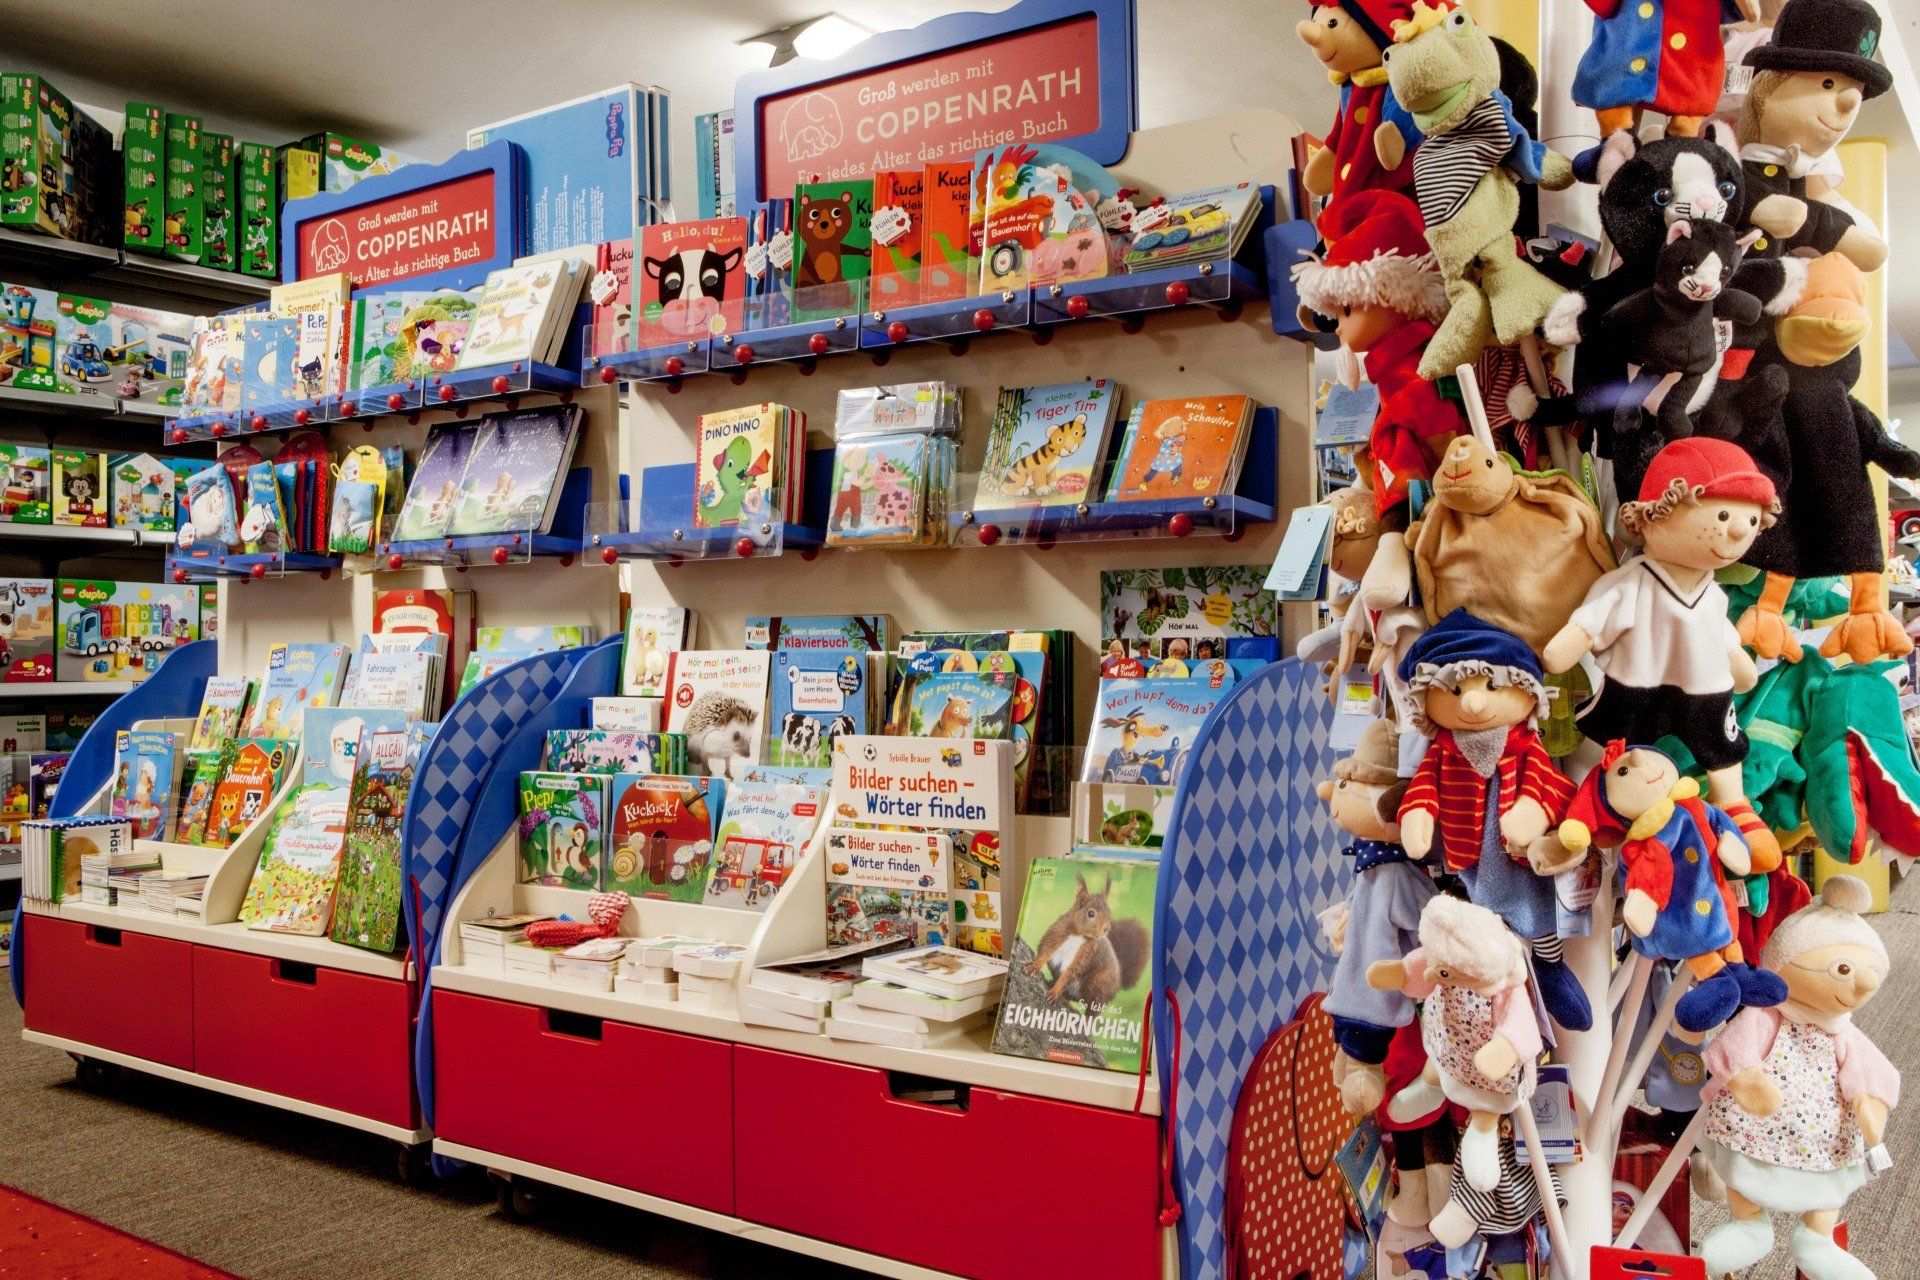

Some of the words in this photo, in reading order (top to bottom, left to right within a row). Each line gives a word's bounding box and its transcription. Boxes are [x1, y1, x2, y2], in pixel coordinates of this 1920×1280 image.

[858, 81, 896, 107] Groß
[902, 66, 959, 95] werden
[966, 59, 994, 78] mit
[856, 67, 1082, 143] COPPENRATH
[608, 103, 623, 138] Peppa
[329, 142, 342, 153] LEGO
[345, 148, 373, 164] duplo
[609, 137, 624, 158] Pig
[826, 161, 866, 185] jedes
[871, 148, 911, 172] Alter
[918, 144, 944, 163] das
[949, 122, 1015, 153] richtige
[1021, 111, 1069, 138] Buch
[358, 215, 381, 232] Groß
[384, 206, 418, 225] werden
[422, 200, 438, 215] mit
[1100, 205, 1127, 218] FÜHLEN
[986, 220, 999, 229] Wer
[357, 209, 488, 261] COPPENRATH
[662, 227, 700, 243] Hallo,
[703, 225, 725, 236] du!
[365, 266, 391, 283] Alter
[394, 261, 409, 276] das
[412, 250, 450, 273] richtige
[453, 242, 480, 262] Buch
[76, 305, 104, 318] duplo
[287, 298, 326, 317] Sommer?
[1045, 392, 1077, 404] Kleiner
[1184, 402, 1206, 411] Mein
[1036, 404, 1070, 420] Tiger
[1074, 400, 1097, 412] Tim
[706, 426, 731, 441] DINO
[733, 418, 760, 433] NINO
[1187, 413, 1235, 428] Schnuller
[62, 588, 76, 596] LEGO
[78, 588, 108, 600] duplo
[784, 636, 848, 648] Klavierbuch
[37, 666, 51, 676] 2+
[687, 659, 702, 667] Hör
[704, 658, 719, 667] mal
[721, 657, 741, 666] rein,
[681, 671, 697, 679] wer
[699, 670, 718, 679] kann
[720, 667, 735, 677] das
[738, 664, 762, 674] sein?
[730, 680, 741, 688] der
[743, 680, 762, 688] Natur
[919, 689, 934, 700] Wer
[936, 681, 960, 694] pupst
[962, 682, 980, 694] denn
[981, 688, 996, 700] da?
[1106, 695, 1130, 710] Wer
[1134, 689, 1165, 702] hupt
[1165, 697, 1190, 714] denn
[1192, 701, 1215, 715] da?
[69, 713, 95, 727] dupl
[889, 754, 909, 763] Sybille
[910, 754, 931, 763] Brauer
[225, 765, 268, 786] Bauernhof
[849, 765, 893, 791] Bilder
[899, 771, 958, 794] suchen
[522, 790, 555, 812] Piep!
[738, 795, 749, 803] Hör
[751, 794, 763, 802] mal
[765, 795, 777, 803] hin!
[866, 792, 923, 817] Wörter
[928, 796, 986, 820] finden
[623, 798, 680, 823] Kuckuck!
[727, 809, 740, 818] Was
[742, 805, 759, 814] fährt
[760, 807, 775, 815] denn
[776, 811, 789, 821] da?
[663, 816, 677, 824] hier?
[848, 835, 875, 851] Bilder
[878, 838, 913, 853] suchen
[851, 854, 884, 869] Wörter
[888, 856, 921, 873] finden
[1078, 998, 1088, 1009] So
[1090, 1002, 1105, 1013] lebt
[1106, 1004, 1122, 1015] das
[1004, 1003, 1141, 1043] EICHHÖRNCHEN
[1062, 1037, 1092, 1048] Bilderreise
[1092, 1041, 1109, 1051] durch
[1110, 1044, 1121, 1052] den
[1122, 1045, 1138, 1055] Wald
[1049, 1052, 1081, 1061] COPPENRATH
